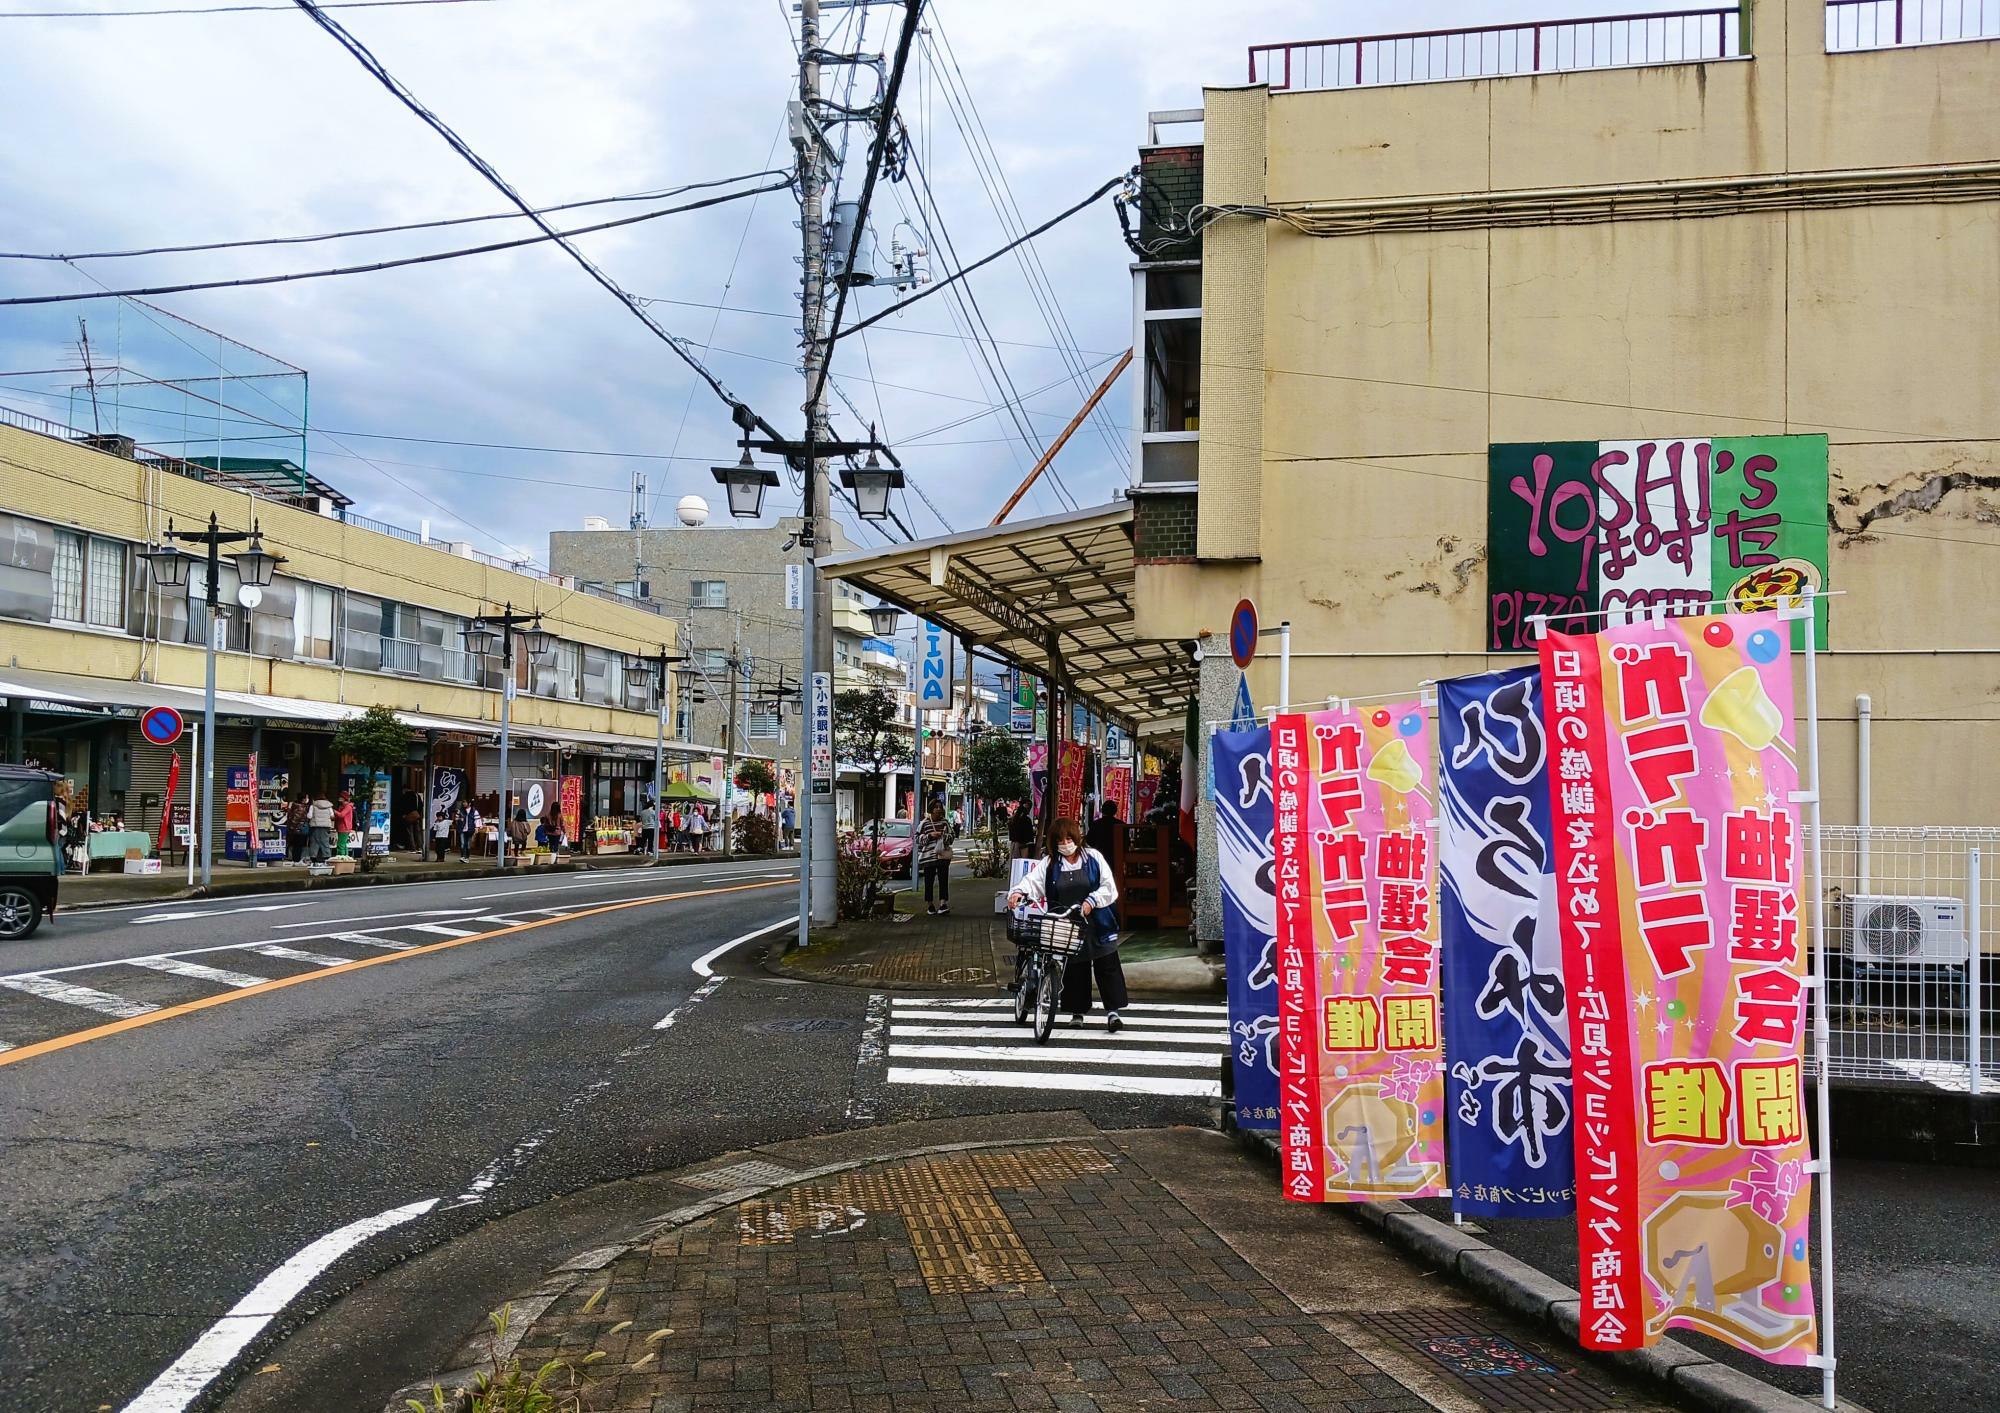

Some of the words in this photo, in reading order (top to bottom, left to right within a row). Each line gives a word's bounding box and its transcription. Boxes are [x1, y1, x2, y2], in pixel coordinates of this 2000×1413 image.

[1510, 441, 1778, 557] YOSHI'S
[816, 690, 829, 746] 小森眼科
[25, 758, 40, 767] Cafe
